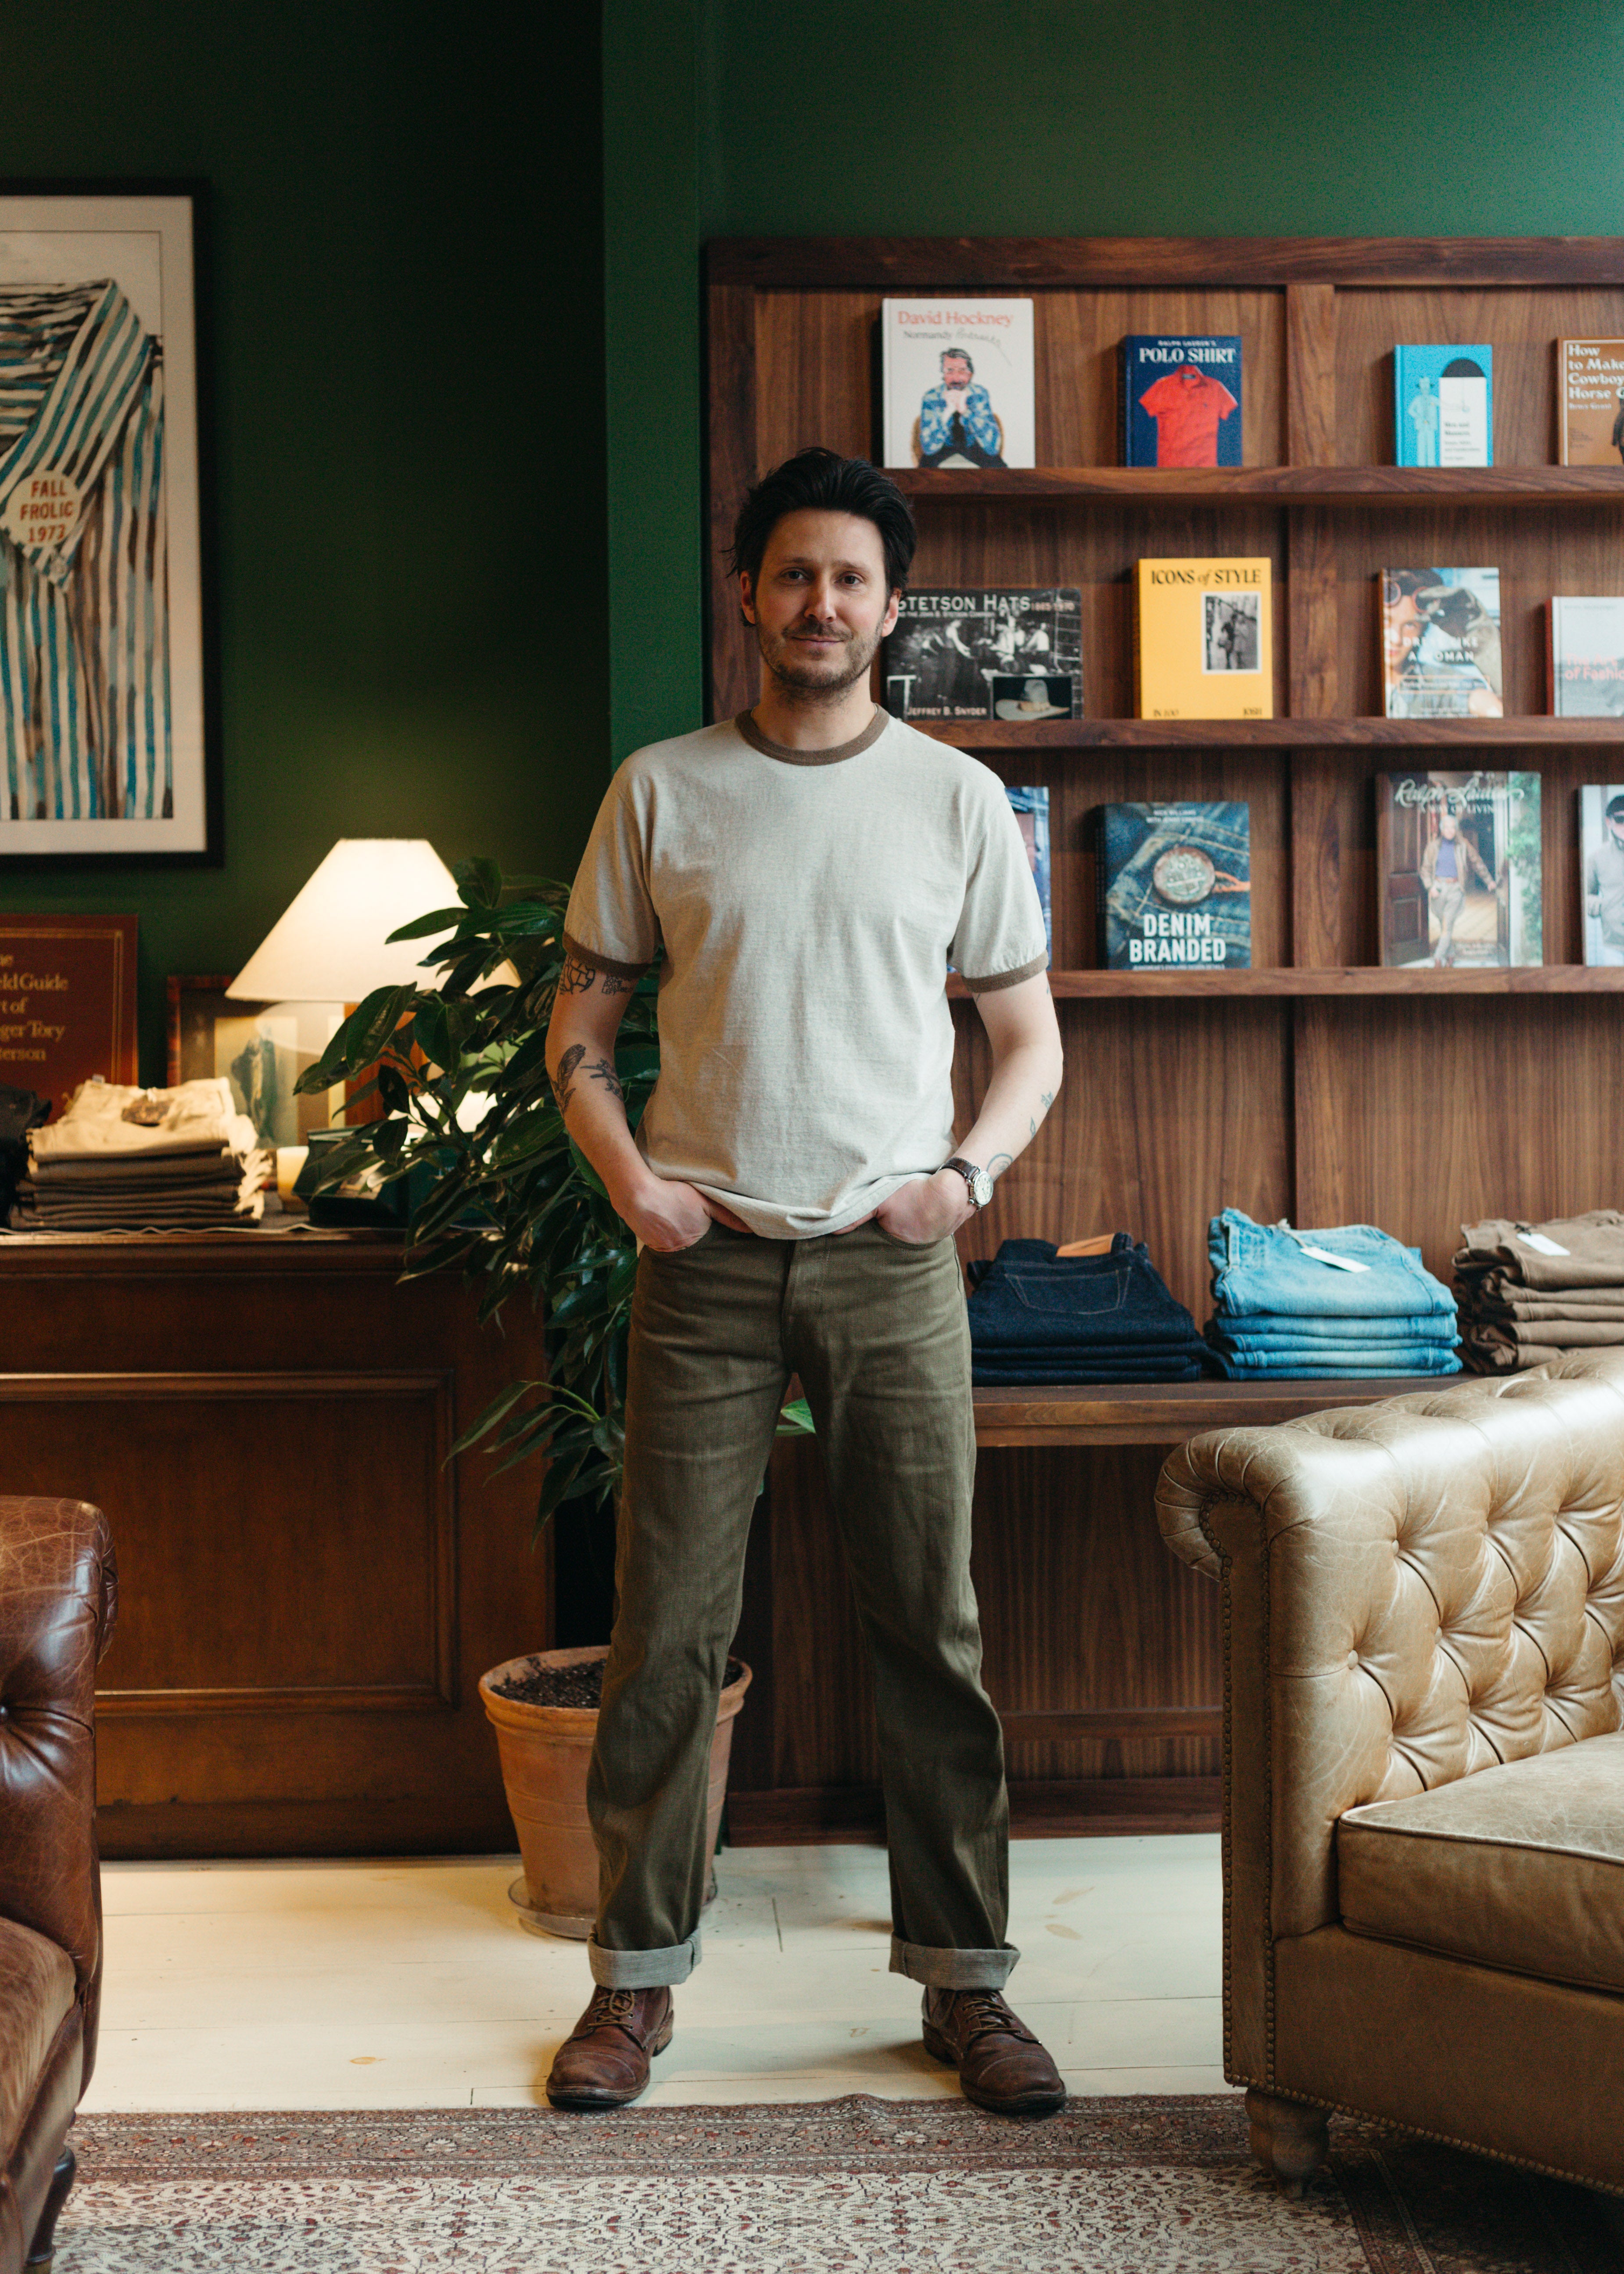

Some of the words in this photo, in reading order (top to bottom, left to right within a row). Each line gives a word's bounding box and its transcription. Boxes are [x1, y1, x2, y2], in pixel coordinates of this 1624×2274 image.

[898, 311, 942, 324] David
[946, 311, 1014, 328] Hockney
[1139, 348, 1185, 363] POLO
[1187, 348, 1236, 363] SHIRT
[1568, 344, 1600, 357] How
[1568, 360, 1584, 370] to
[1568, 372, 1624, 387] Cowboy
[1568, 387, 1612, 399] Horse
[32, 481, 66, 498] FALL
[20, 501, 74, 520] FROLIC
[29, 524, 65, 542] 1977
[1151, 570, 1195, 585] ICONS
[1198, 569, 1212, 586] of
[1215, 568, 1261, 584] STYLE
[983, 594, 1030, 611] HATS
[1408, 650, 1417, 661] A
[1565, 652, 1590, 666] The
[1594, 653, 1618, 667] Art
[1565, 666, 1581, 680] of
[943, 706, 954, 716] B.
[1395, 778, 1444, 814] Ralph
[1143, 913, 1211, 938] DENIM
[1129, 938, 1226, 963] BRANDED
[19, 972, 69, 991] Guide
[10, 996, 29, 1014] of
[26, 1020, 65, 1043] Tory
